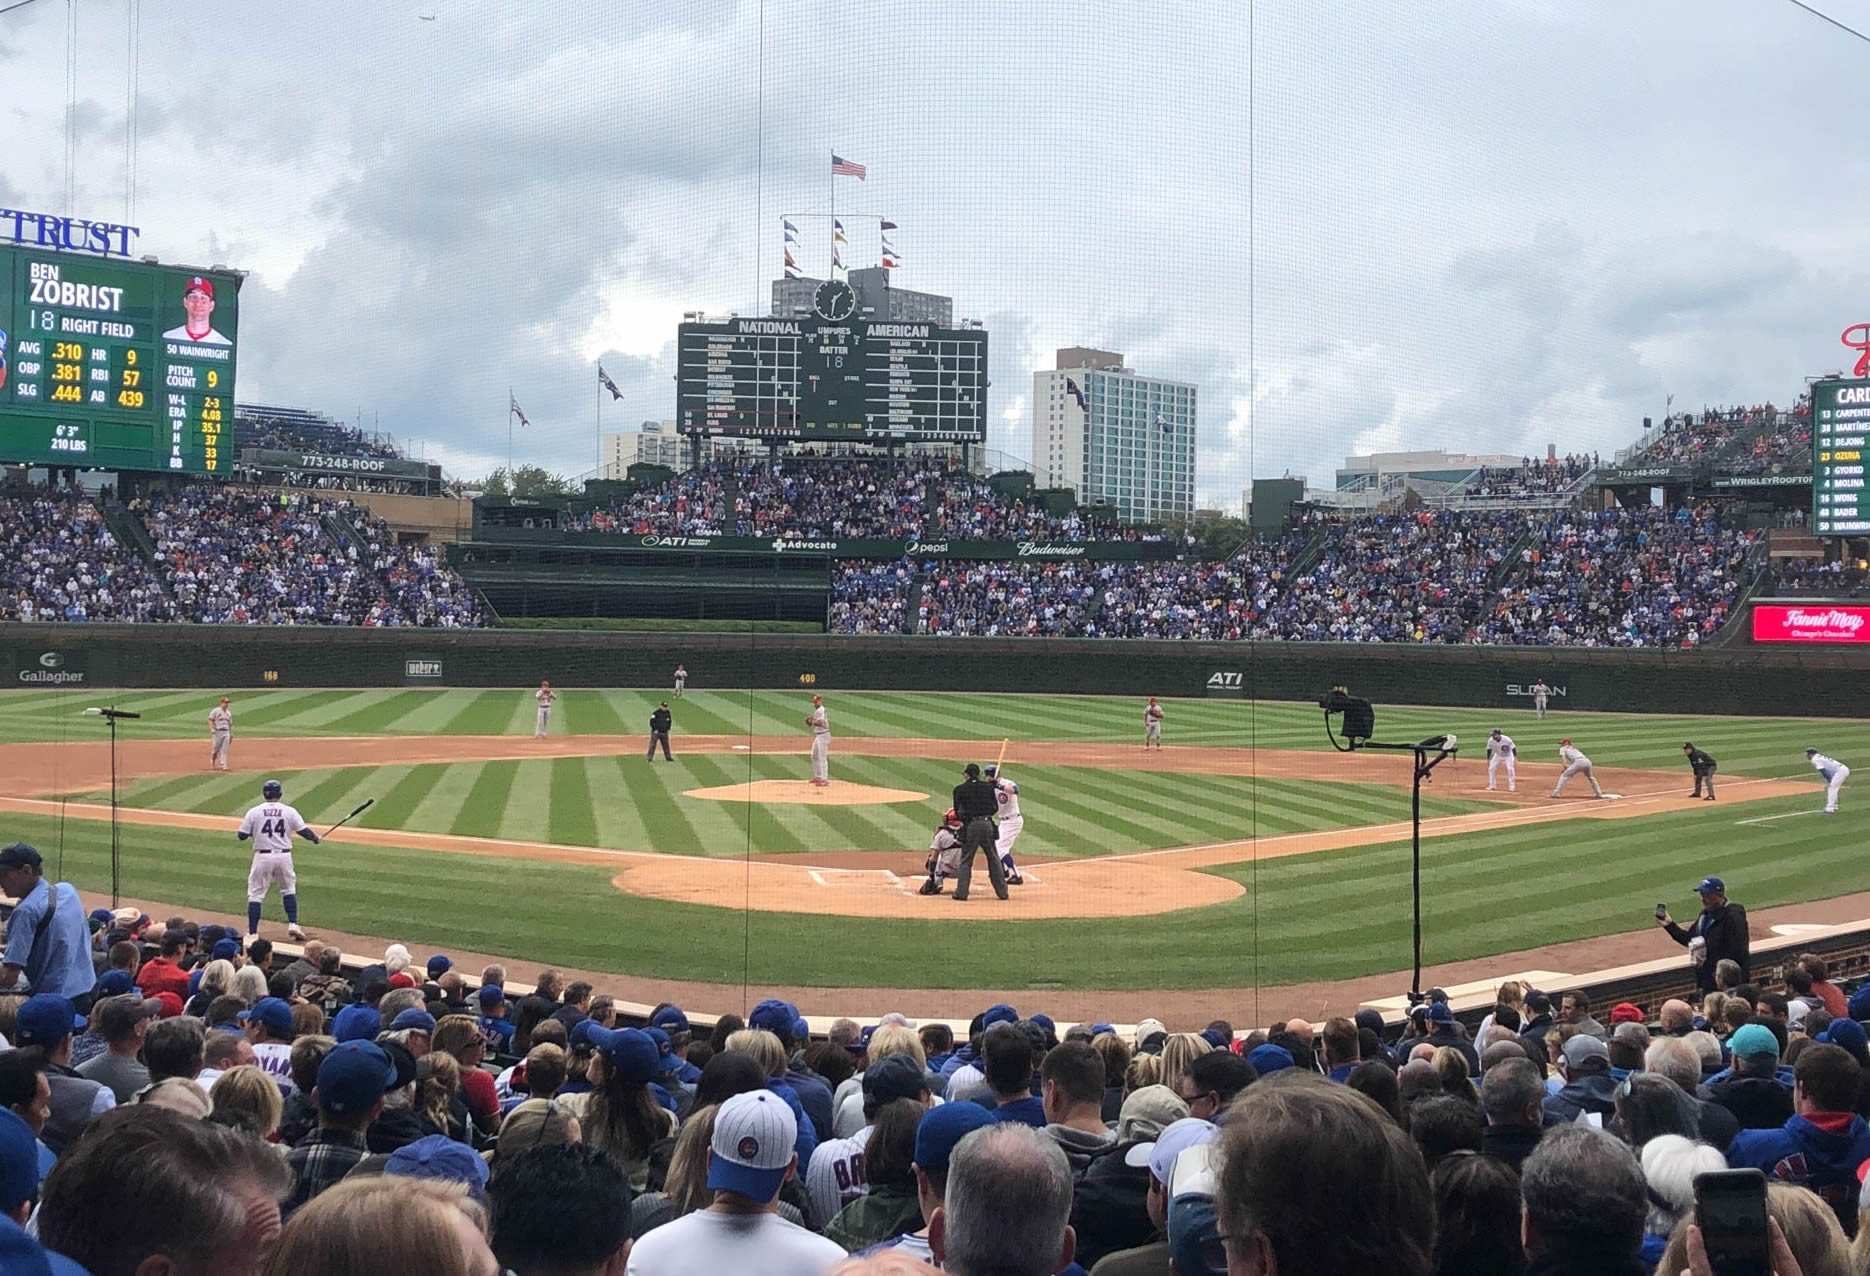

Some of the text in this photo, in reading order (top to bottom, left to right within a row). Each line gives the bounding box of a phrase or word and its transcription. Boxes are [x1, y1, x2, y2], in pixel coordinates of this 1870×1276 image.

[3, 209, 140, 256] TRUST
[30, 262, 59, 281] BEN
[30, 279, 123, 312] ZOBRIST
[61, 318, 134, 338] RIGHT FIELD
[739, 321, 802, 334] NATIONAL
[866, 325, 930, 337] AMERICAN
[18, 341, 137, 366] AVG .310 HR 9
[166, 344, 230, 360] 50 WAINWRIGHT
[819, 346, 848, 355] BATTER
[18, 362, 140, 387] OBP .381 RBI 57
[168, 364, 218, 388] PITCH 9
[166, 376, 197, 388] COUNT
[17, 383, 144, 408] SLG .444 AB 439
[168, 393, 220, 408] W-L 2-3
[168, 406, 187, 418] ERA
[1822, 409, 1831, 419] 13
[172, 419, 221, 434] IP 35.1
[1821, 424, 1831, 433] 38
[51, 438, 87, 451] 210 LBS
[172, 432, 217, 446] H 37
[1821, 436, 1865, 447] 12 DEJONG
[172, 445, 217, 459] K 33
[1821, 450, 1861, 462] 23 OZUNA
[169, 457, 217, 471] BB 17
[301, 455, 385, 472] 773-248-ROOF
[1823, 465, 1864, 476] 3 GYORKO
[1823, 478, 1865, 489] 4 MOLINA
[1820, 493, 1858, 503] 16 WONG
[1833, 507, 1858, 517] BADER
[1819, 520, 1870, 531] 50 WAINWRI
[659, 537, 687, 546] ATI
[787, 540, 837, 550] Advocate
[920, 542, 948, 554] pepsi
[1017, 541, 1085, 556] Budweiser
[1783, 609, 1864, 631] Fannie May
[19, 670, 84, 684] Gallagher
[1207, 672, 1243, 685] ATI
[261, 818, 286, 839] 44
